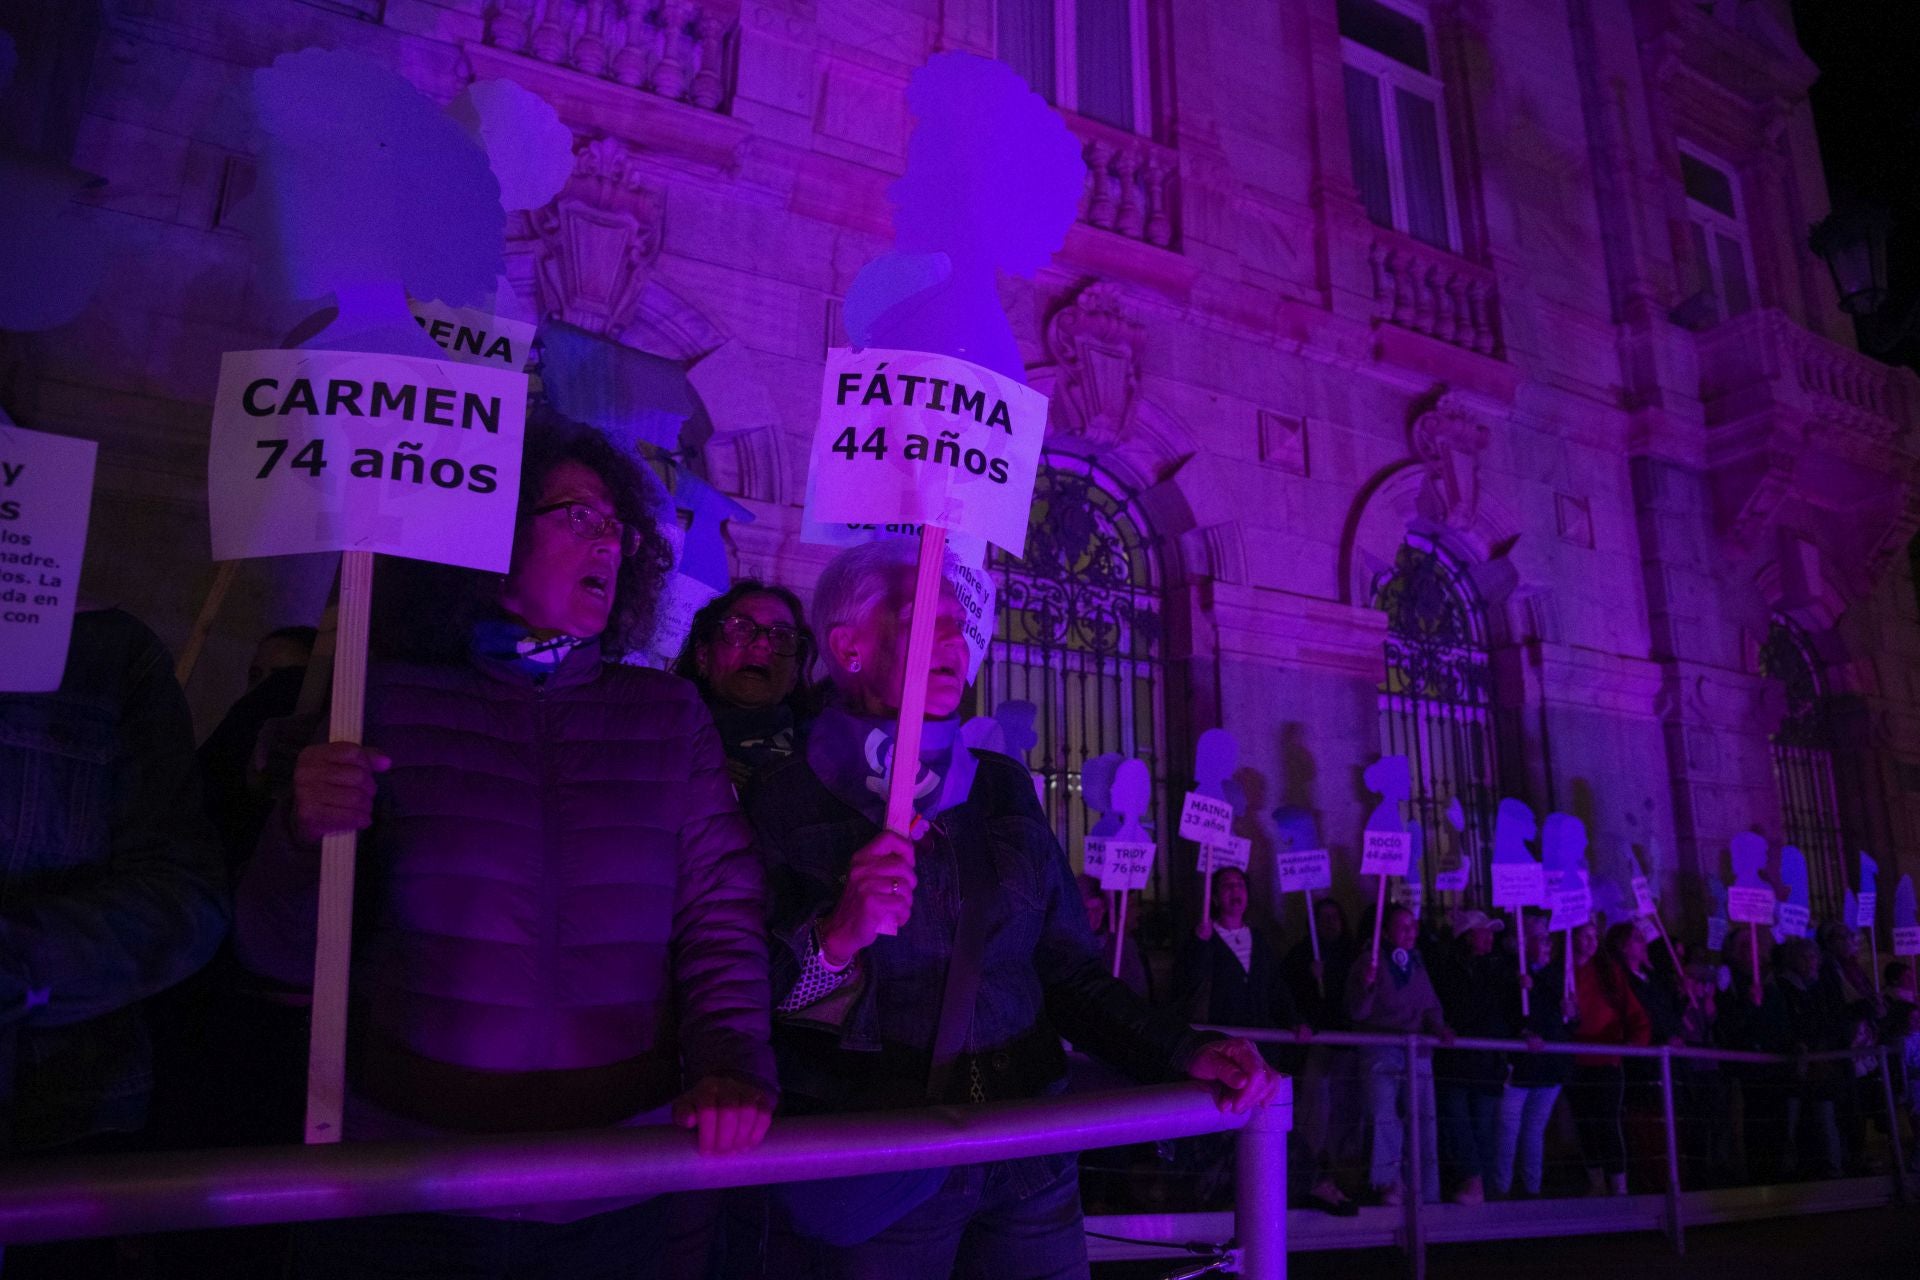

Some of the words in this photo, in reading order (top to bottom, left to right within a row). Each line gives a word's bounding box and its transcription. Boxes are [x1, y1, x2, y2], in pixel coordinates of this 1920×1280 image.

[241, 378, 501, 435] CARMEN
[836, 362, 1013, 436] FÁTIMA
[255, 439, 327, 479] 74
[350, 441, 498, 494] años
[831, 426, 888, 460] 44
[903, 430, 1009, 484] años
[0, 569, 31, 584] os.
[39, 573, 62, 588] La
[0, 588, 27, 604] da
[33, 593, 59, 607] en
[4, 611, 40, 624] con
